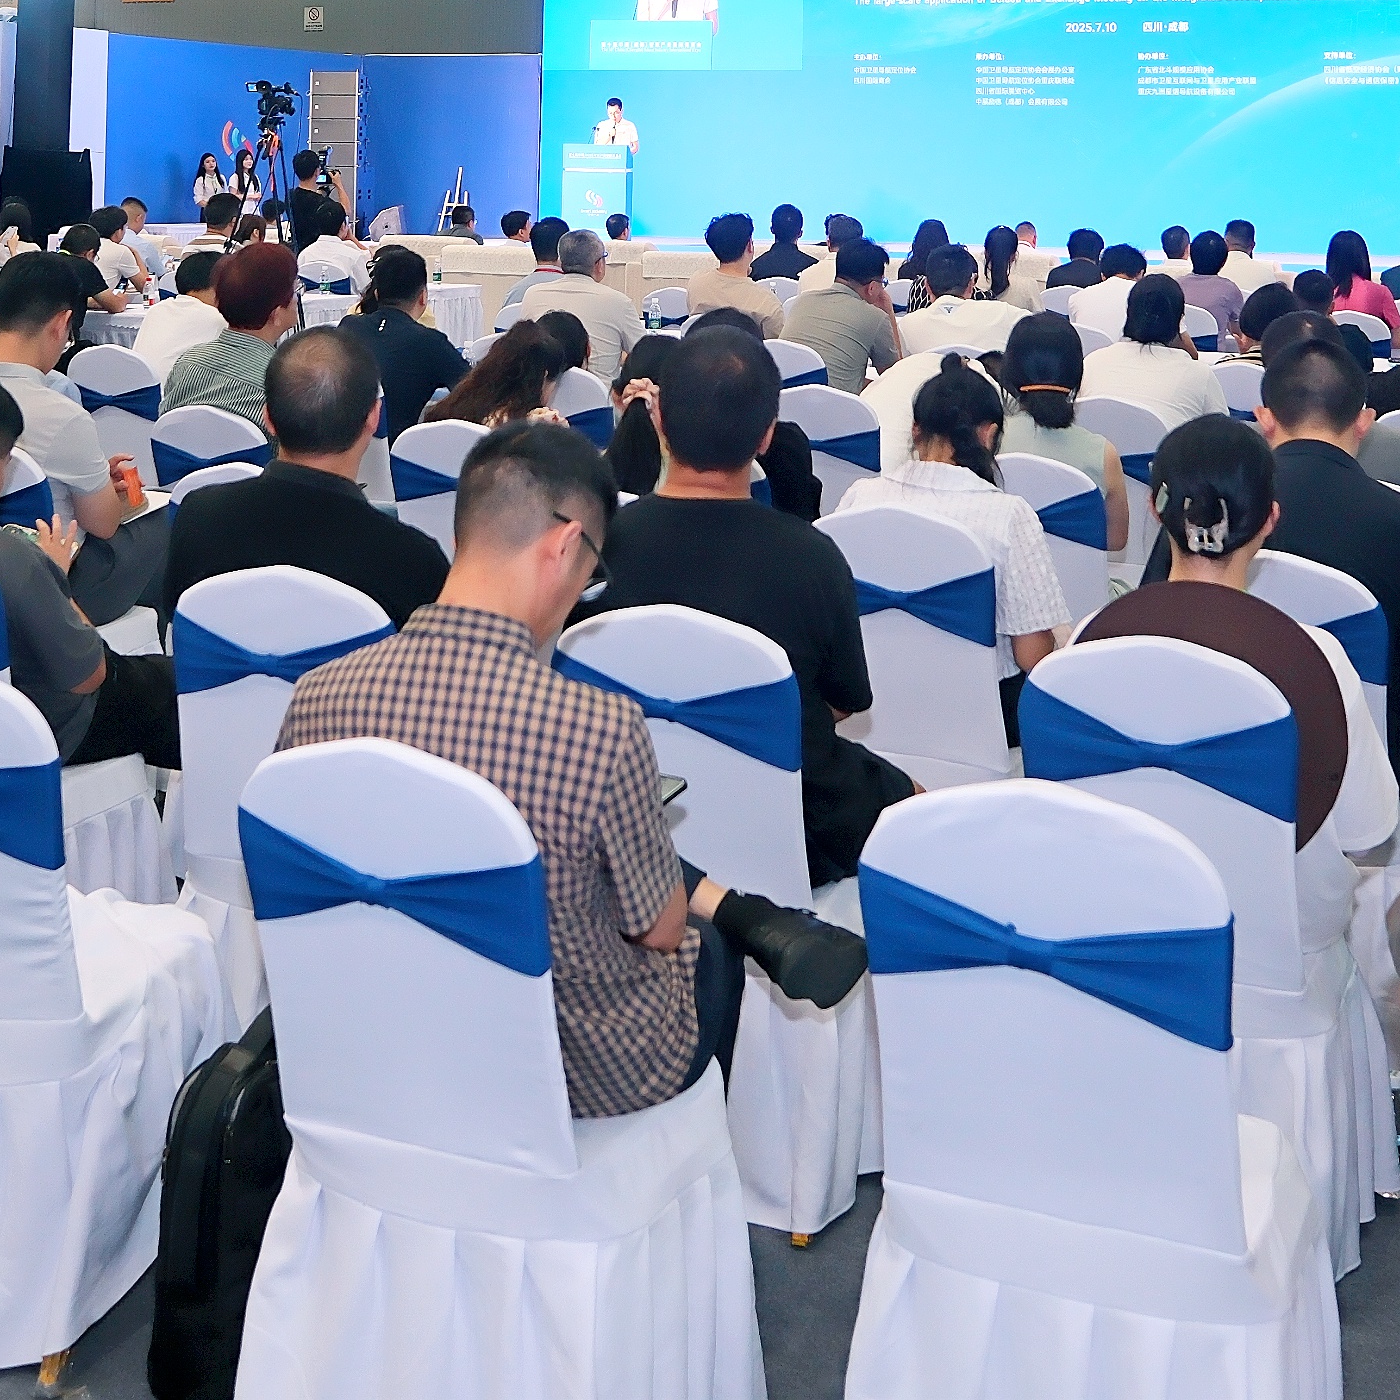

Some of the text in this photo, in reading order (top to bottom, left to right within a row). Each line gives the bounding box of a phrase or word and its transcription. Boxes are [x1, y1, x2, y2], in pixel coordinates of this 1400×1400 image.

[1065, 21, 1189, 33] 2025.7.10 四川·成都
